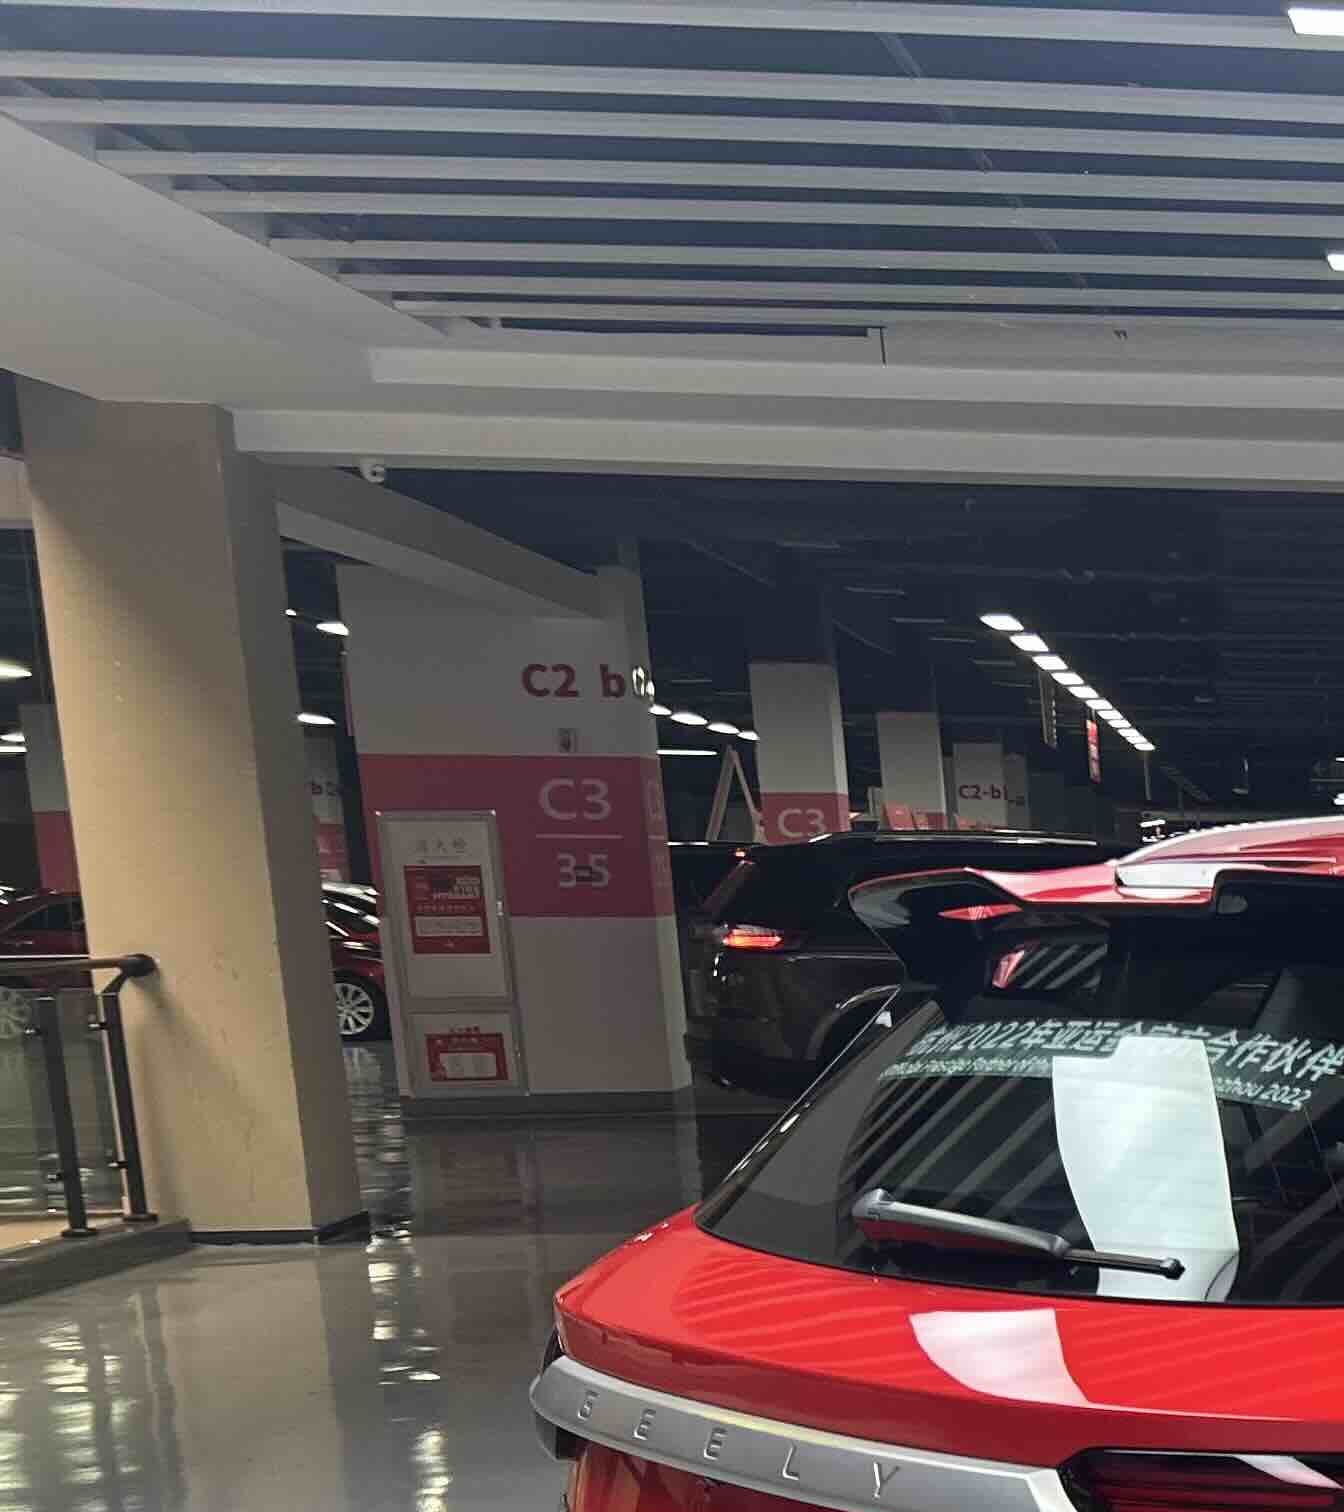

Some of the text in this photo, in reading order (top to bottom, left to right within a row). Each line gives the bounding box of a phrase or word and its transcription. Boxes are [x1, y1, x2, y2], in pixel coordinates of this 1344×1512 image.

[539, 778, 611, 821] C3
[777, 809, 825, 838] C3
[577, 1388, 901, 1499] GEELY
